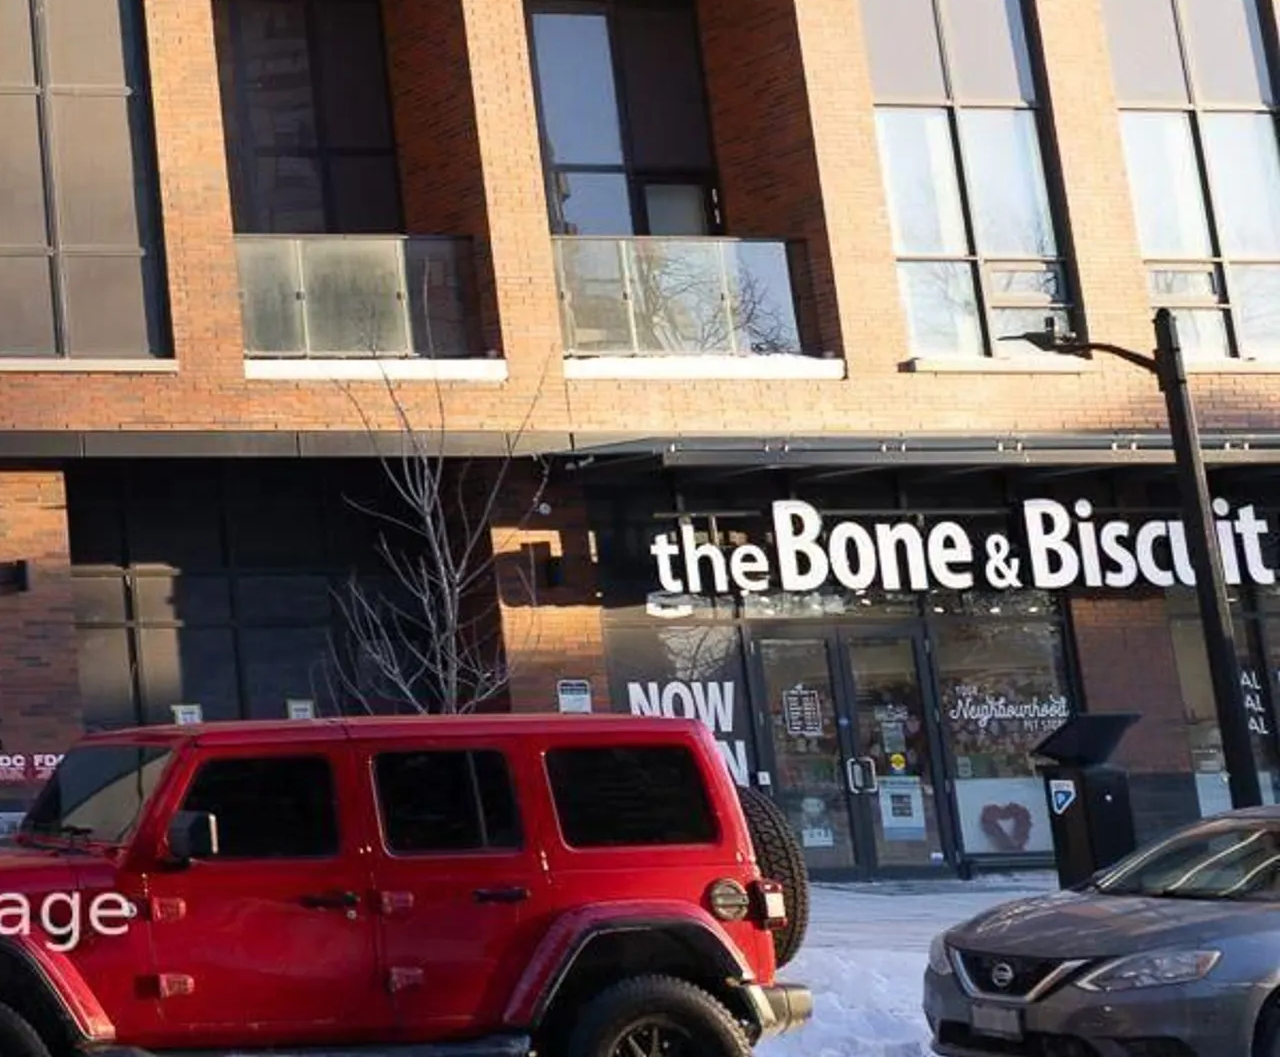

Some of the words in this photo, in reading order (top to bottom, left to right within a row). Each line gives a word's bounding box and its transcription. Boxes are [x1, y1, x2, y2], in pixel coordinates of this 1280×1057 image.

[651, 524, 769, 593] the
[772, 499, 973, 592] Bone
[985, 533, 1020, 588] &
[627, 681, 734, 732] NOW
